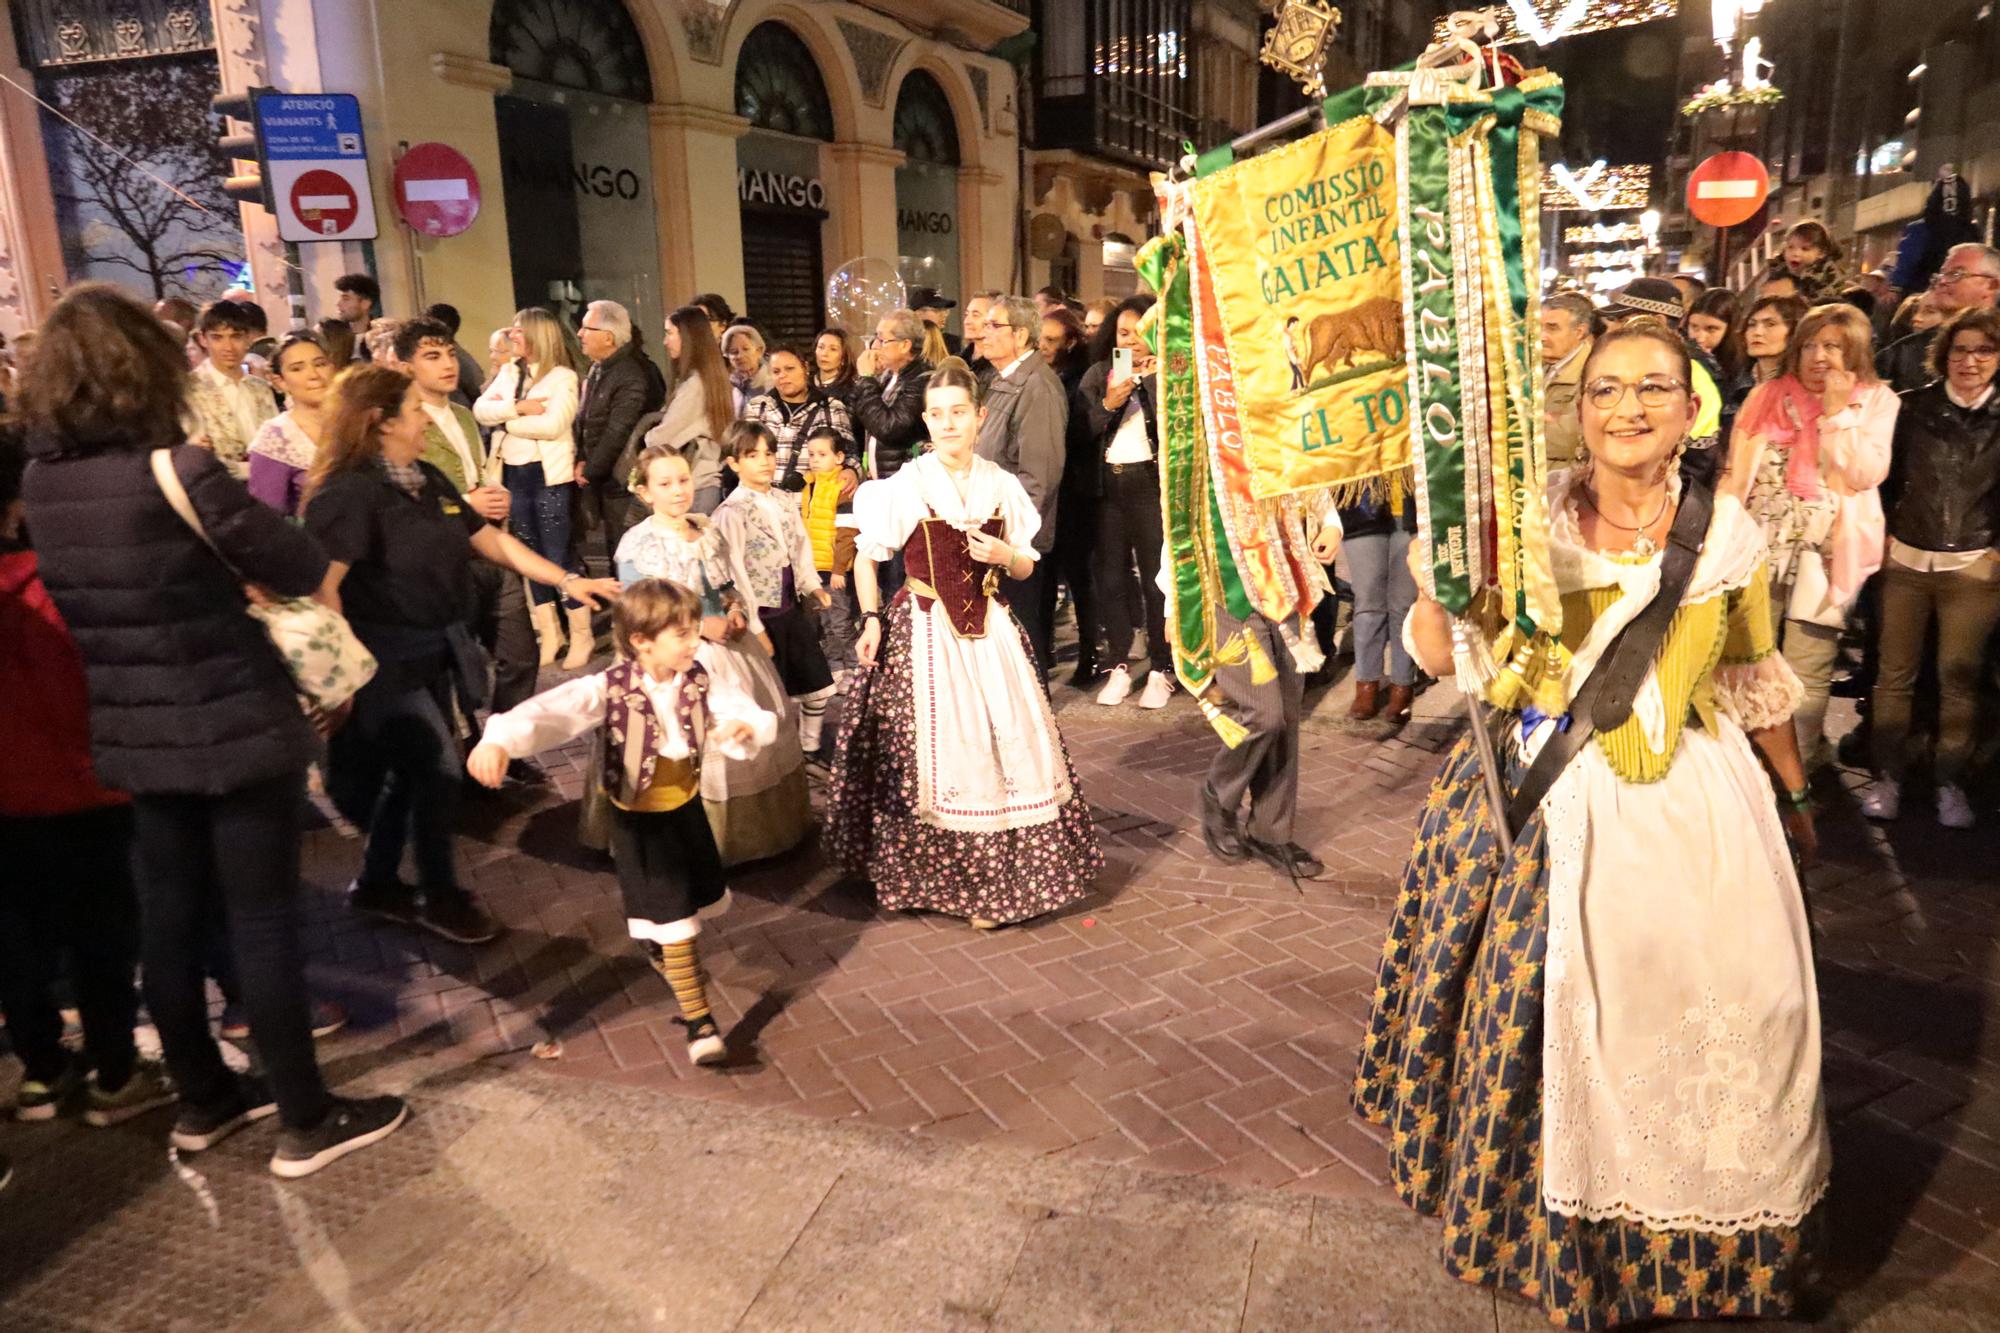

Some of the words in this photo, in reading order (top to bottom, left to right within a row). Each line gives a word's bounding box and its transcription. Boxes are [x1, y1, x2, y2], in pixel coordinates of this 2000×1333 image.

[1271, 193, 1387, 255] INFANTIL
[1261, 235, 1388, 305] GAIATA
[1414, 205, 1457, 447] PABLO
[1206, 343, 1243, 449] PABLO
[1301, 408, 1343, 452] EL
[1353, 383, 1411, 434] TO
